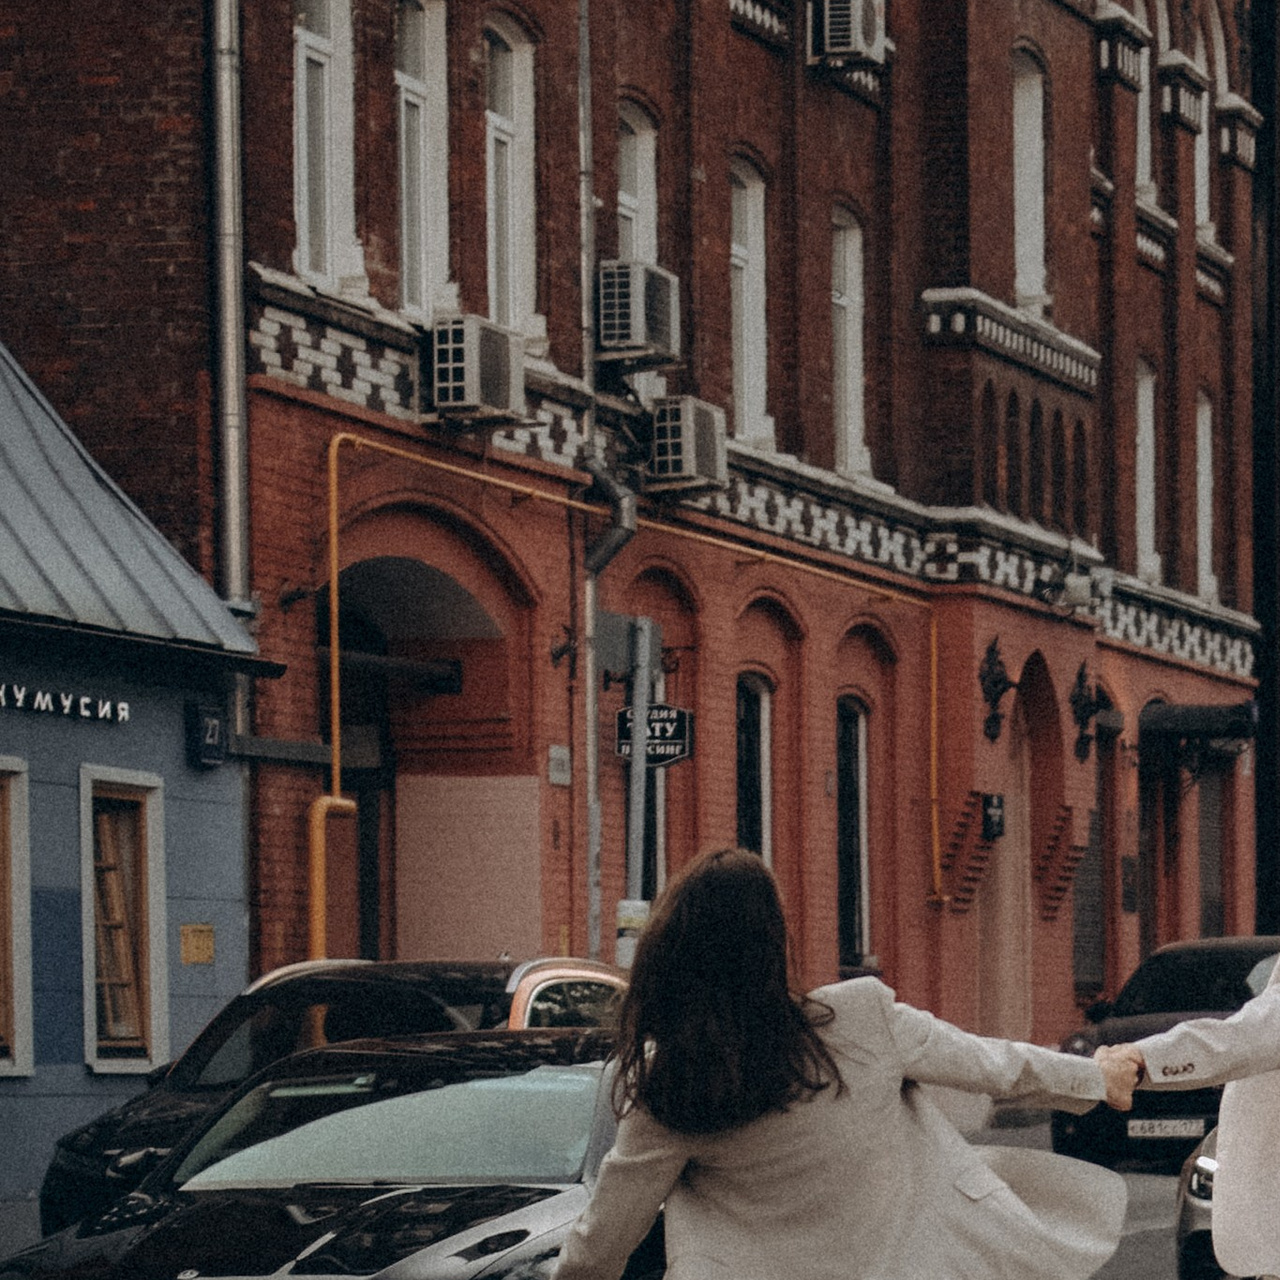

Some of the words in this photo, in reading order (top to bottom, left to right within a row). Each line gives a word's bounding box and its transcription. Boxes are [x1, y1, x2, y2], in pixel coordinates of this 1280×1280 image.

[626, 709, 678, 719] СДИЯ
[626, 722, 677, 737] ТУ
[621, 745, 683, 755] ПСИНГ
